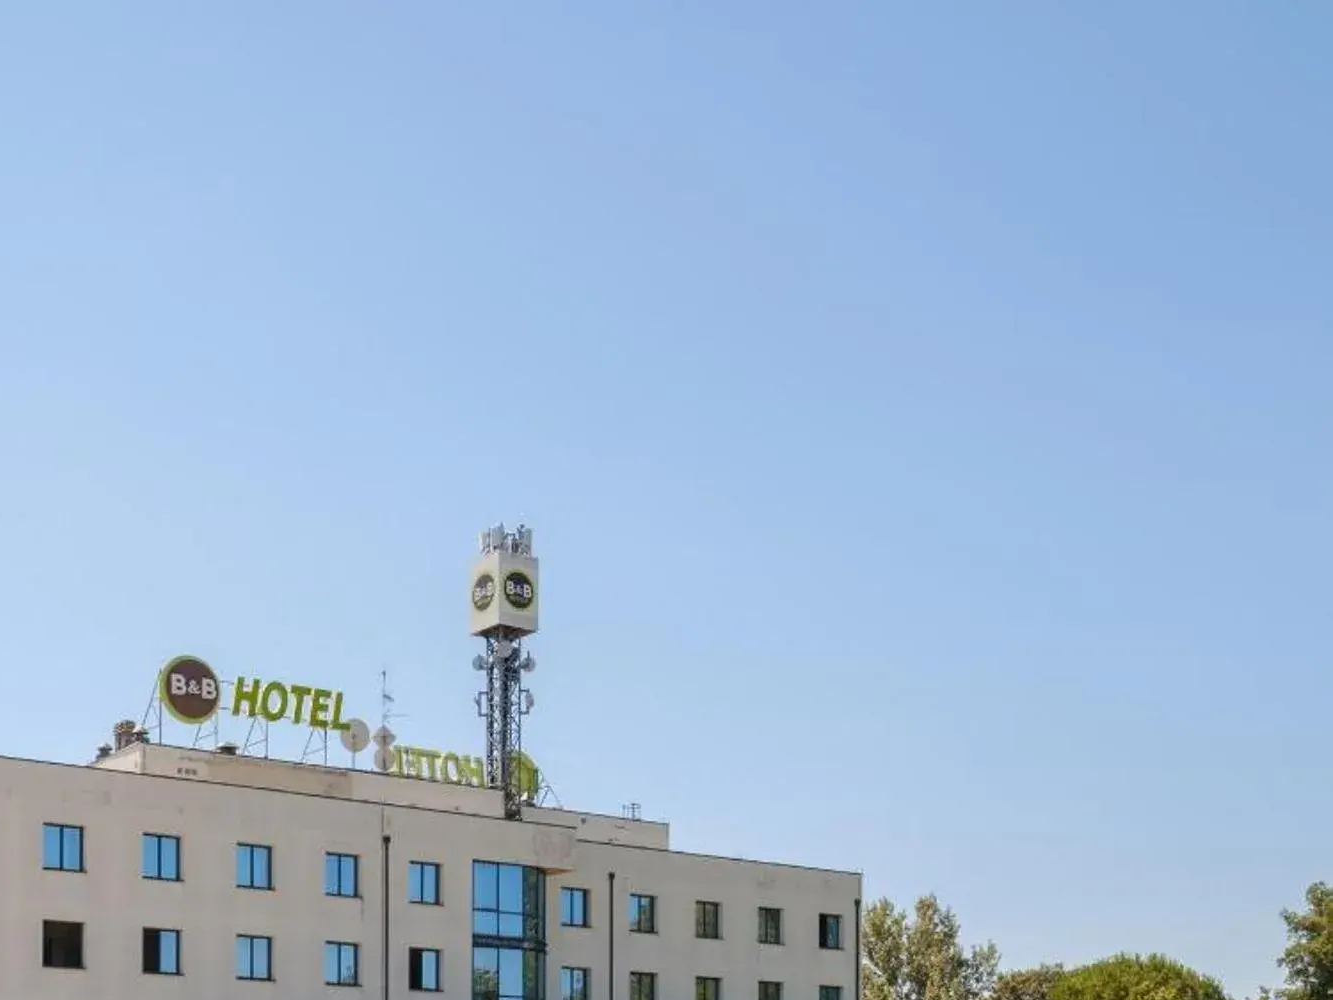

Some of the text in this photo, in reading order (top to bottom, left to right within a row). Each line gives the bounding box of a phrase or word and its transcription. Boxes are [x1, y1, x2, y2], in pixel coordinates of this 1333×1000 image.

[506, 580, 532, 598] B&B
[171, 673, 351, 731] B&B HOTEL
